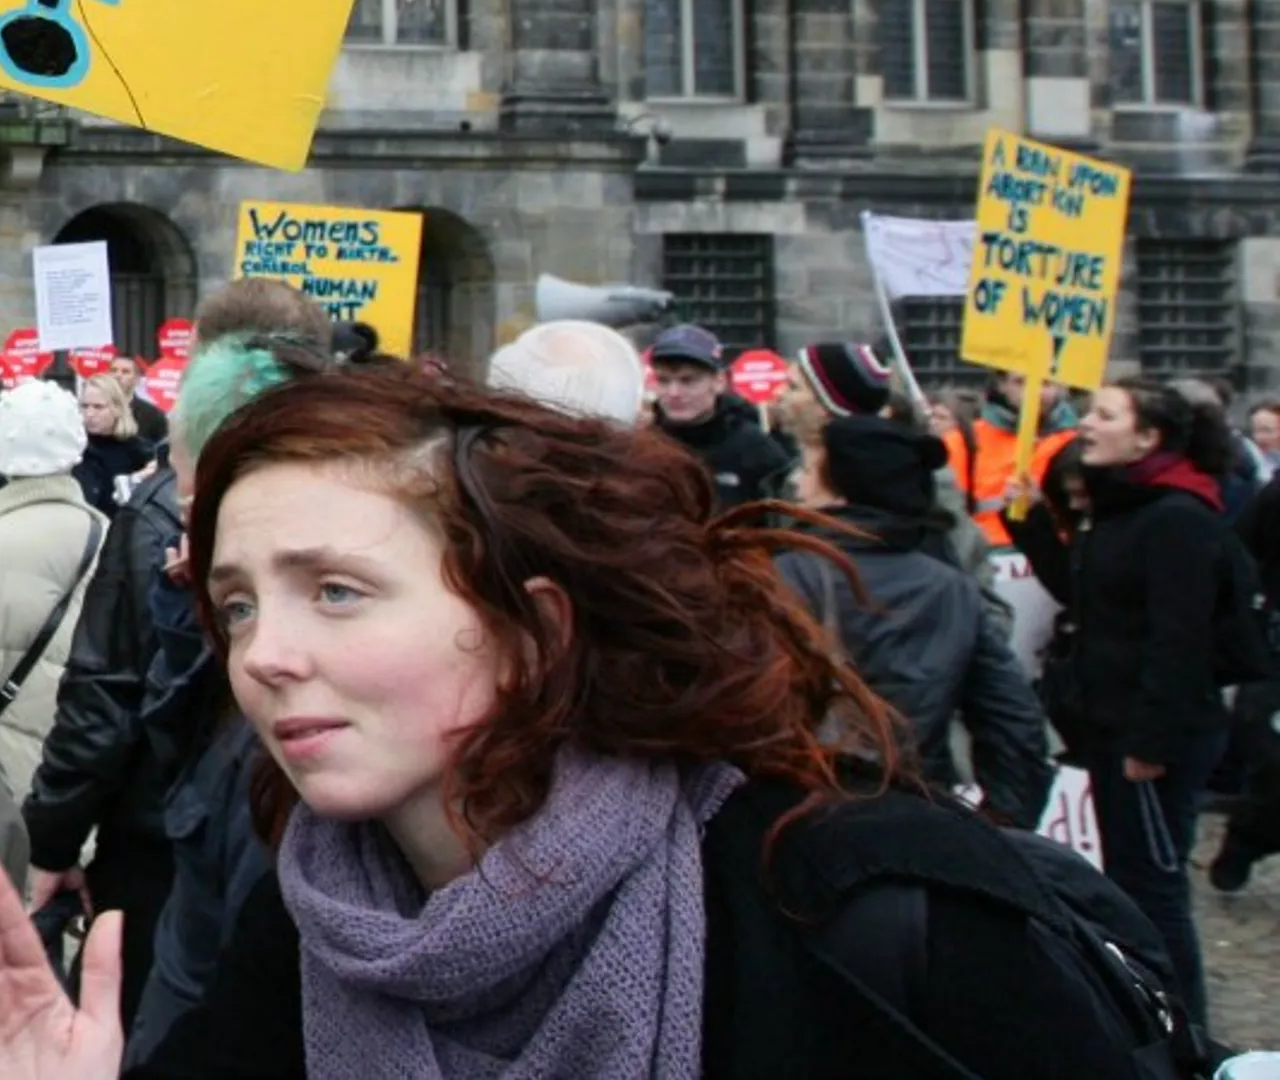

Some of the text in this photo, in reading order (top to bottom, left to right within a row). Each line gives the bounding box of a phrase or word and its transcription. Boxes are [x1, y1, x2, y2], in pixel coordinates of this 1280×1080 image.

[991, 136, 1006, 166] A
[1069, 164, 1119, 197] UPON
[1009, 201, 1029, 234] IS
[245, 240, 297, 258] RIGHT
[304, 243, 329, 259] TO
[981, 231, 1105, 291] TORTURE
[302, 276, 378, 300] HUMAN
[974, 278, 1109, 338] OF WOMEN
